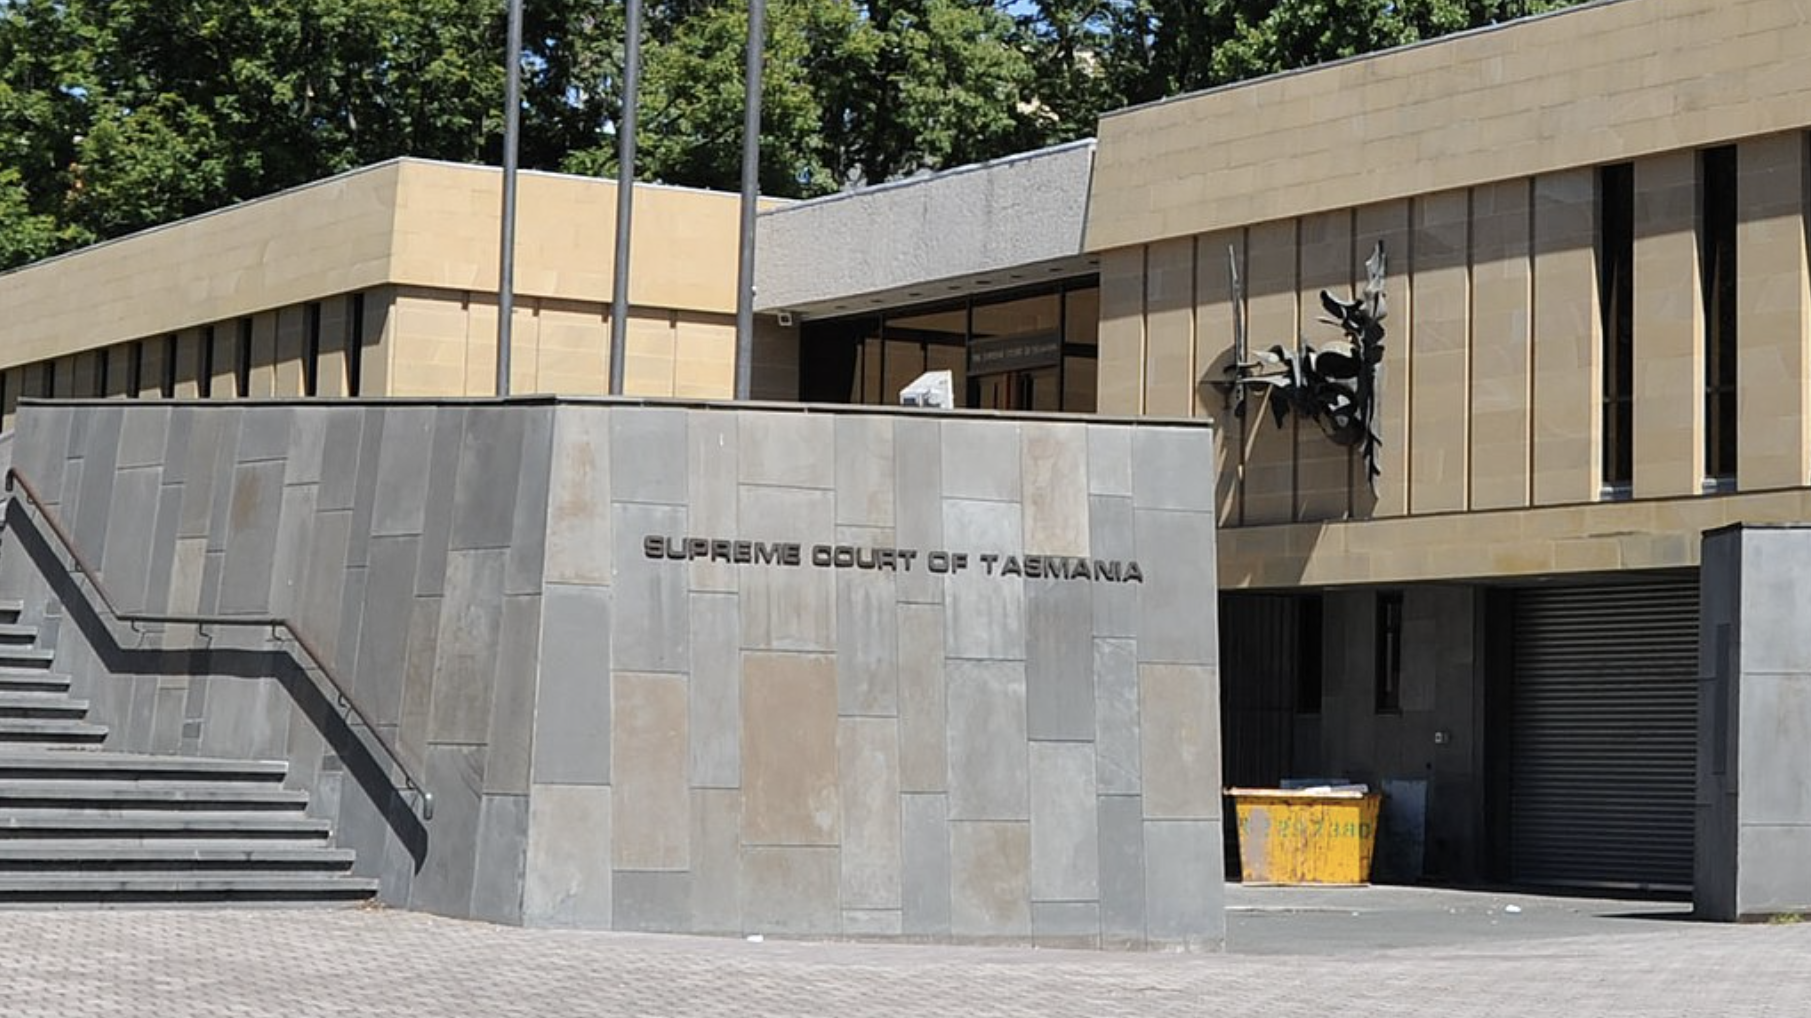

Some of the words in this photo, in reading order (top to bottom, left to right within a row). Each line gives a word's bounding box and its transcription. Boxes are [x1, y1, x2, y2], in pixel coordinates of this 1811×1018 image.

[644, 535, 801, 566] SUPREME
[812, 544, 917, 571] COURT
[928, 551, 968, 574] OF
[980, 554, 1143, 583] TASMANIA
